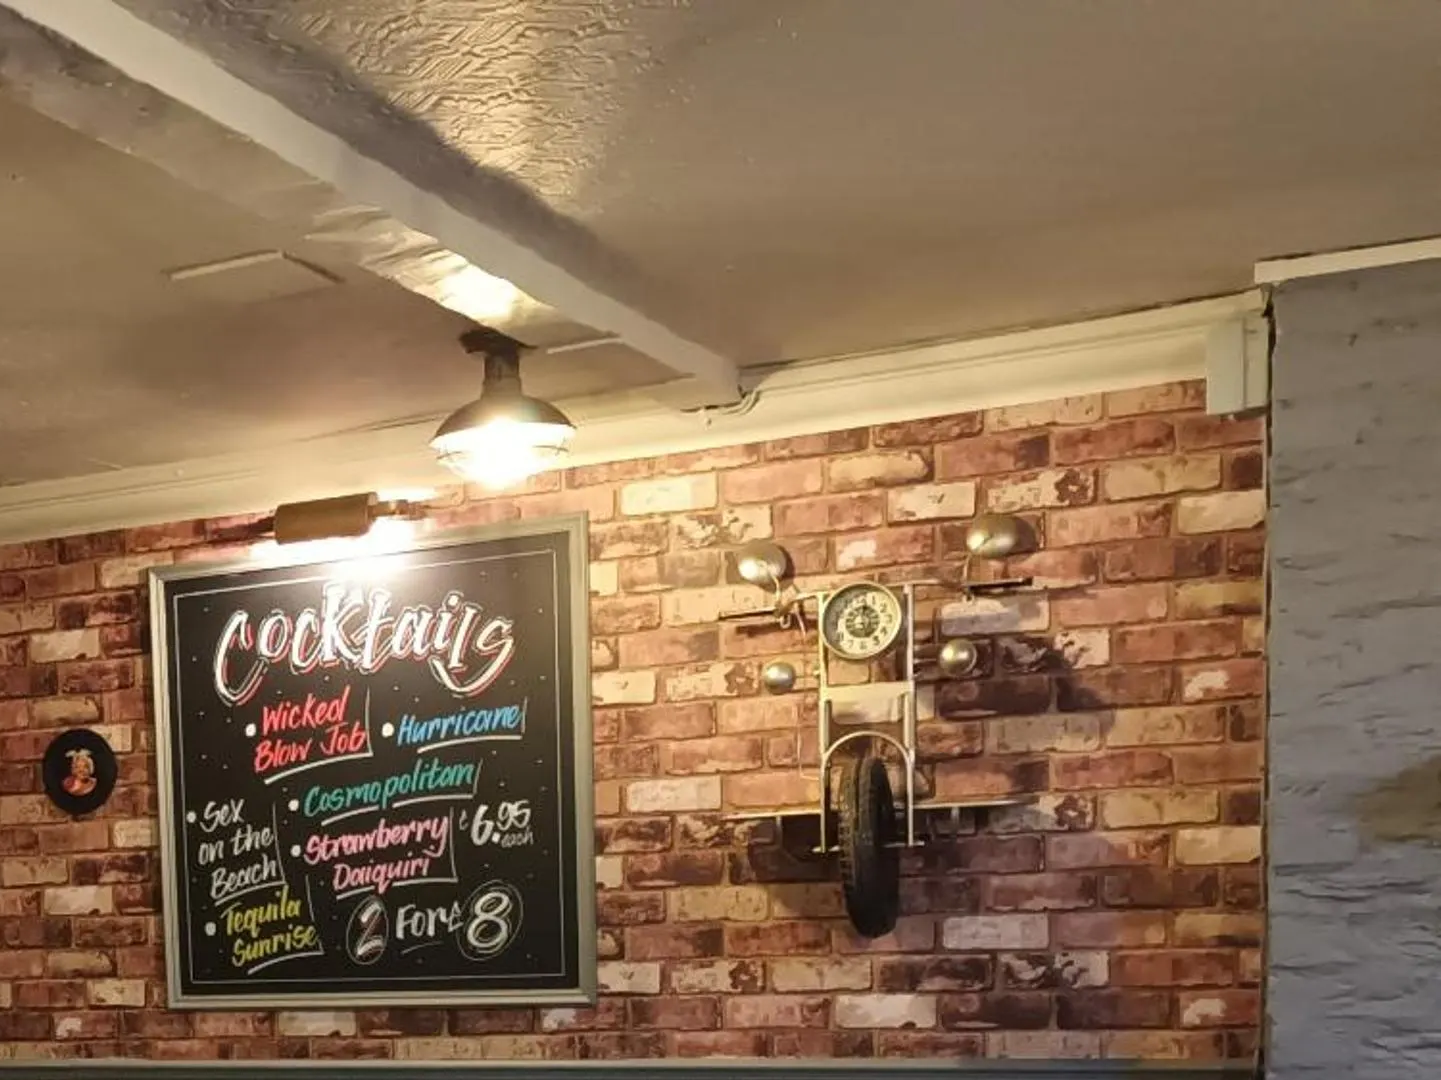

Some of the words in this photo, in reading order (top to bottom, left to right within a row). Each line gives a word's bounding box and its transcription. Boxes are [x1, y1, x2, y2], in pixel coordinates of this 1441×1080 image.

[262, 685, 350, 735] Wicked
[397, 704, 521, 746] Hurricane
[254, 740, 311, 773] Blow
[320, 721, 367, 755] Job
[304, 759, 475, 817] Cosmopolitan
[200, 799, 245, 832] Sex
[198, 840, 224, 865] on
[230, 824, 274, 856] the
[304, 816, 449, 865] Strawberry
[211, 853, 276, 899] Beach
[332, 852, 431, 893] Daiquiri
[220, 884, 302, 938] Tequila
[356, 902, 385, 956] 2
[232, 924, 319, 967] Sunrise
